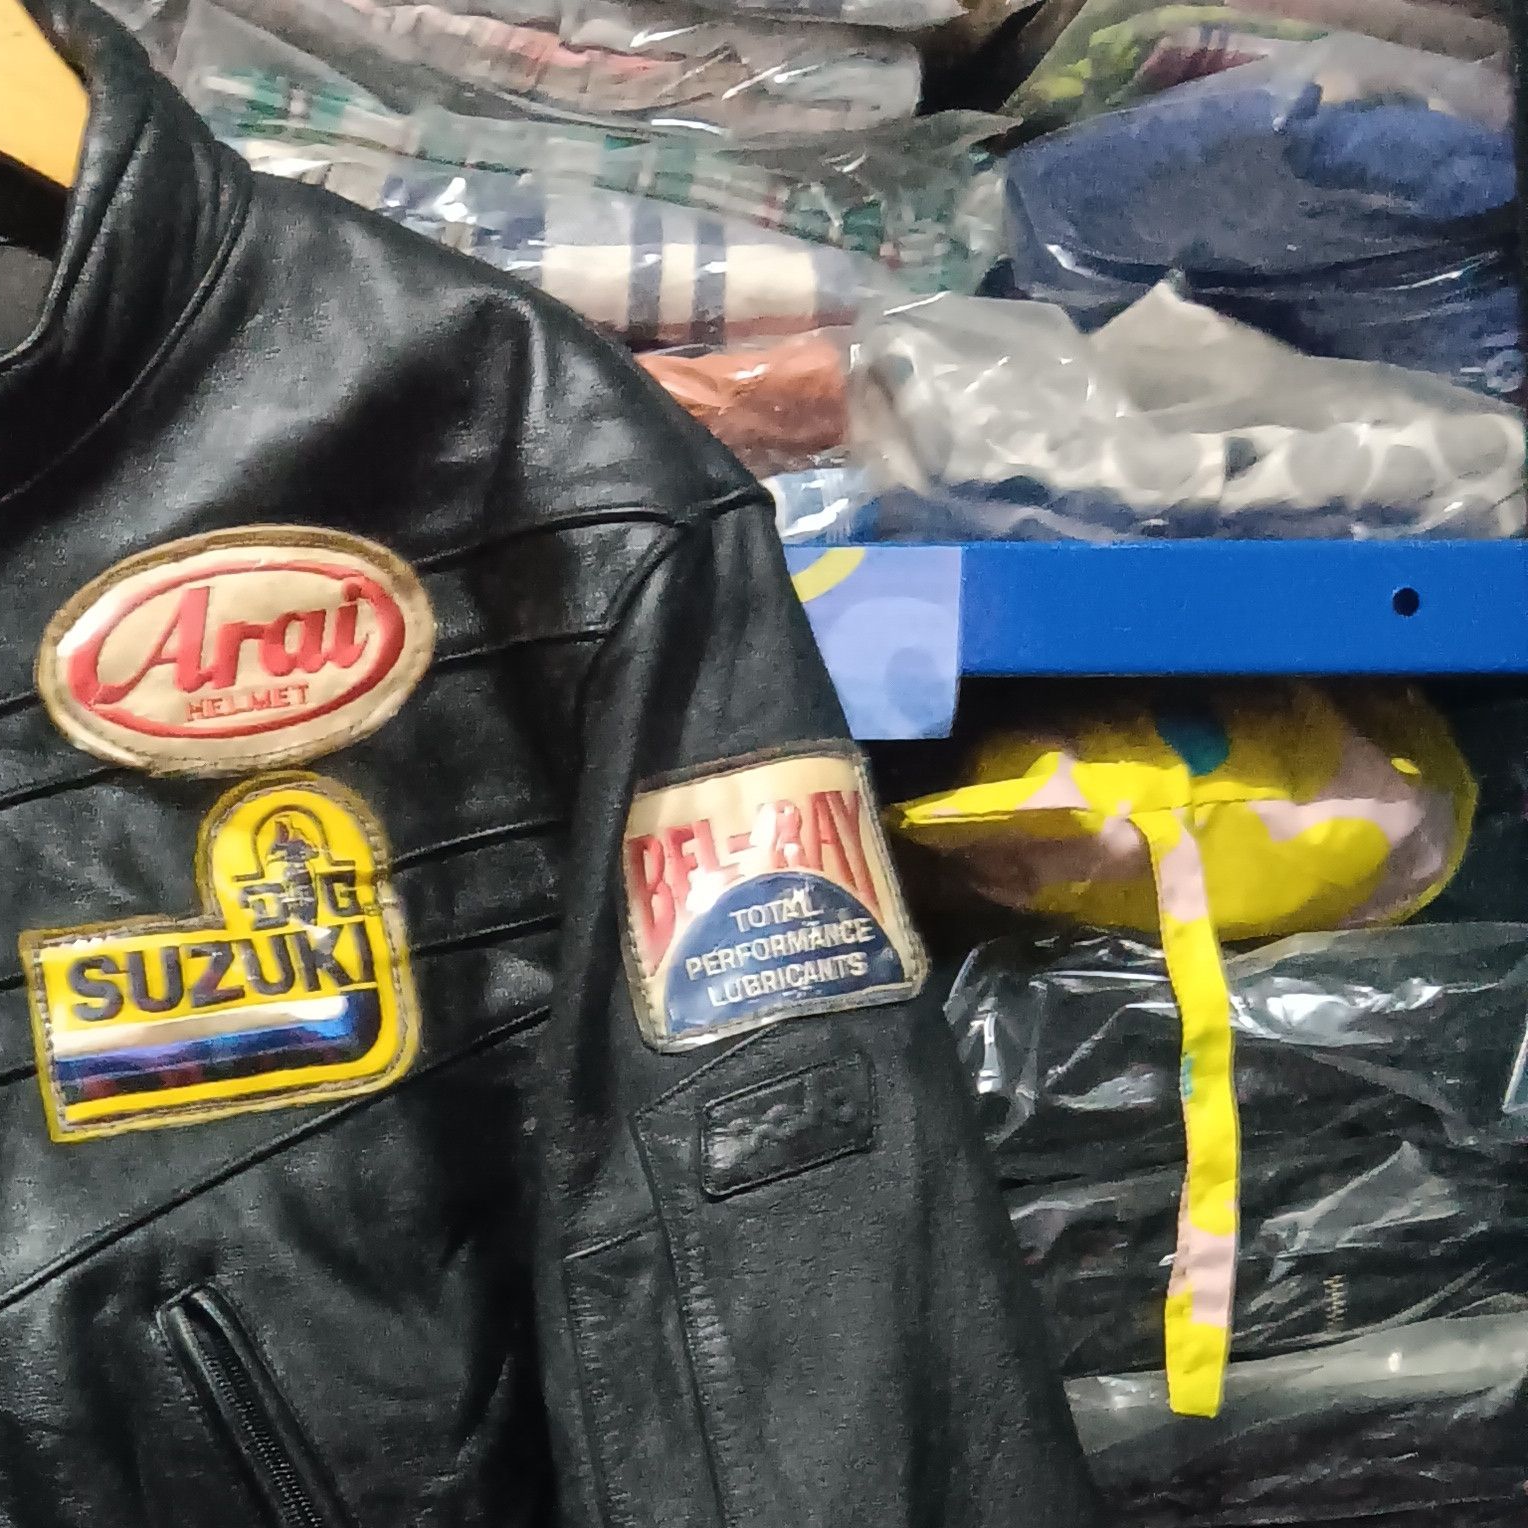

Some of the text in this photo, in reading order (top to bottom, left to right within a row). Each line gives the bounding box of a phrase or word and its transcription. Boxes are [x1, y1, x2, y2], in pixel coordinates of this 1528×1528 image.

[88, 576, 370, 705] Arai
[186, 682, 309, 722] HELMET
[628, 790, 884, 977] BEL-RAY
[729, 885, 822, 933] TOTAL
[68, 920, 375, 1022] SUZUKI
[684, 916, 876, 981] PERFORMANCE
[707, 951, 869, 1007] LUBRICANTS
